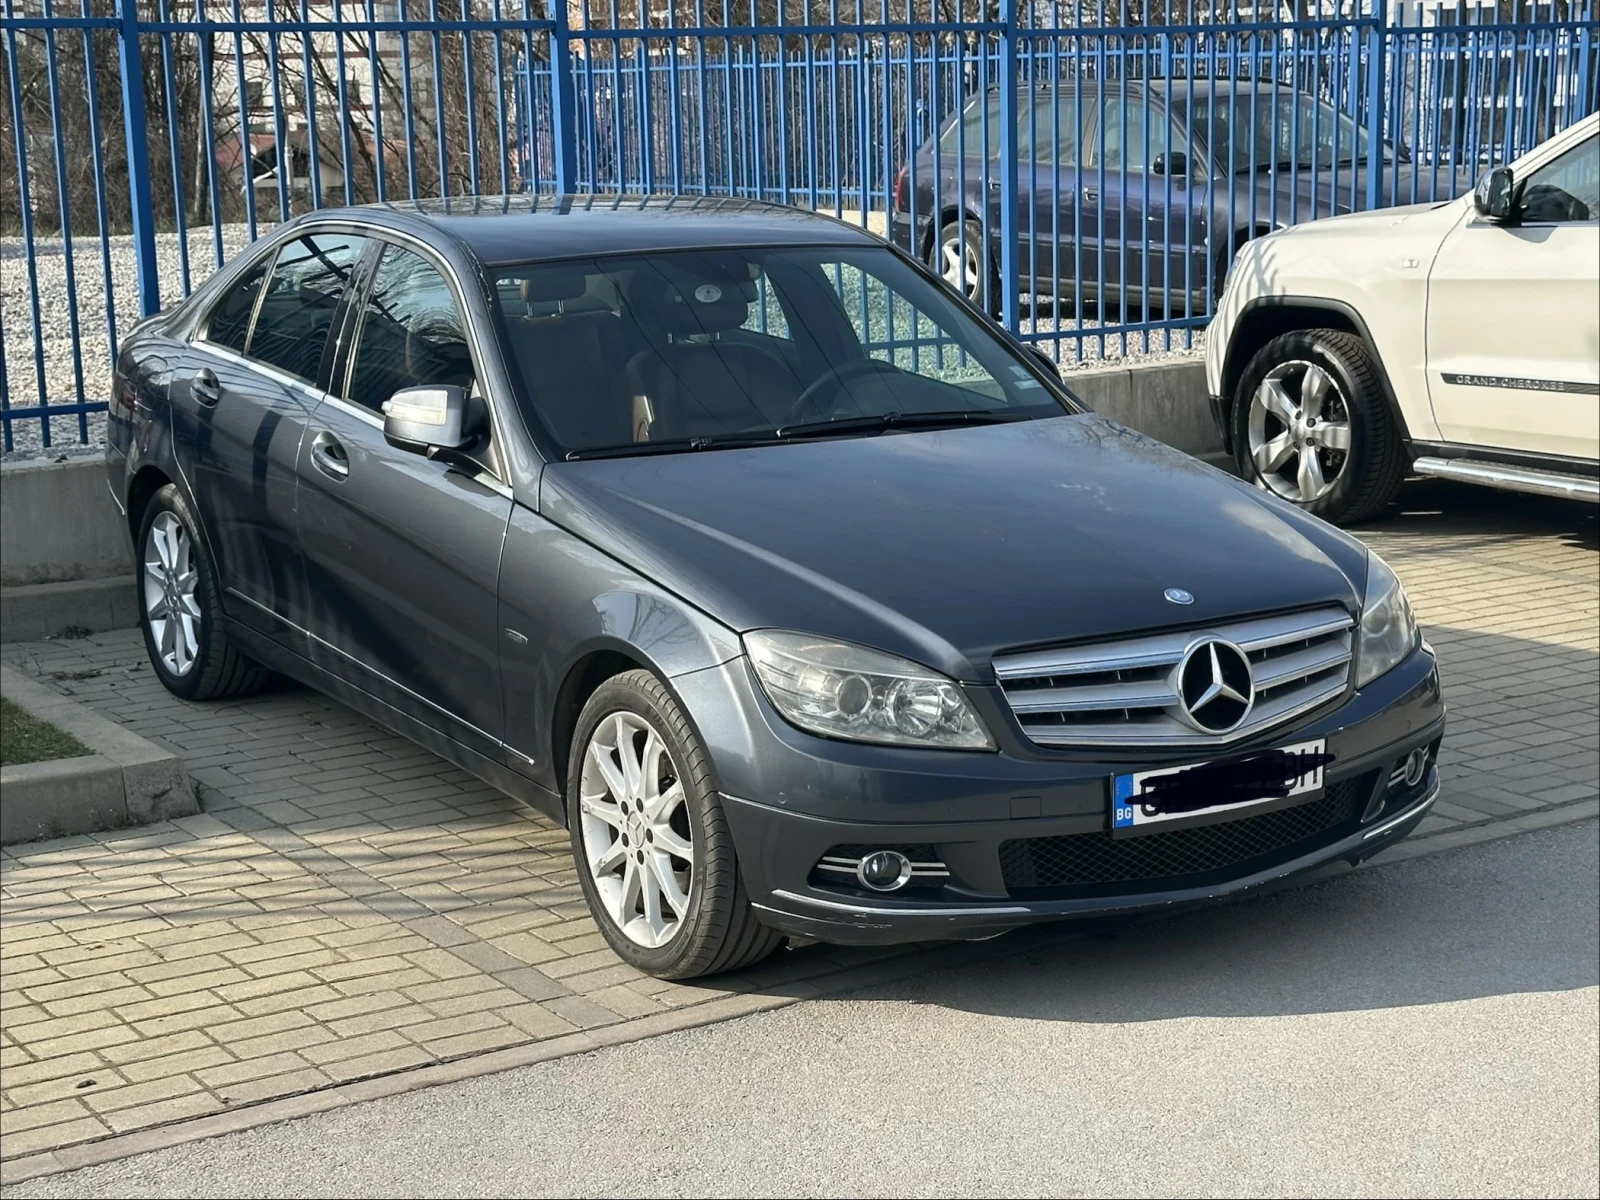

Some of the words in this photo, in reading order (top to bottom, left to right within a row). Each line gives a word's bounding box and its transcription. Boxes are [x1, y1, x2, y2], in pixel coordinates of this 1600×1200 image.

[1456, 375, 1497, 386] GRAND
[1500, 378, 1565, 391] CHEROKEE
[1116, 807, 1132, 821] BG
